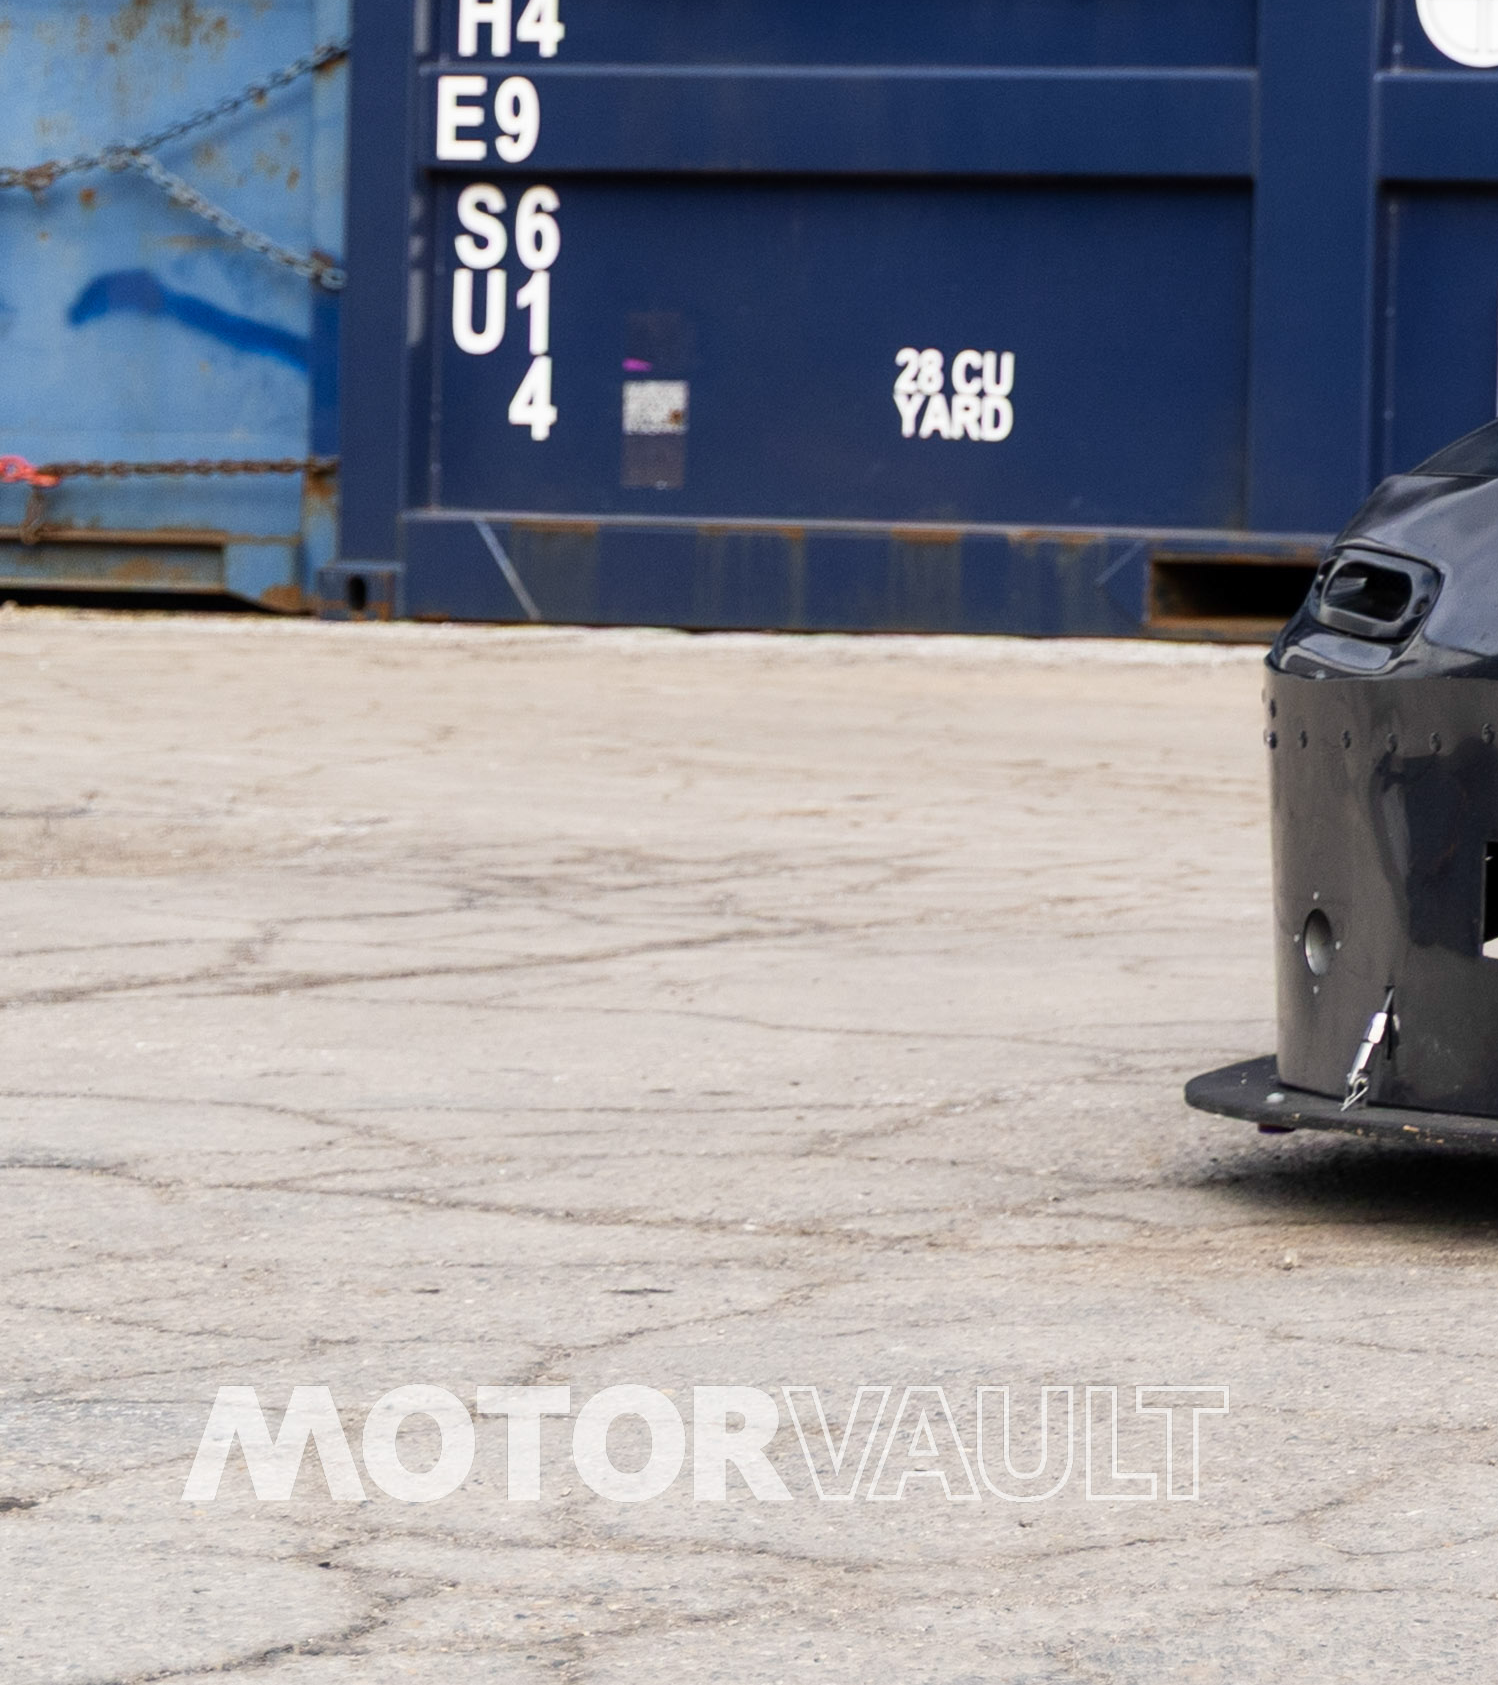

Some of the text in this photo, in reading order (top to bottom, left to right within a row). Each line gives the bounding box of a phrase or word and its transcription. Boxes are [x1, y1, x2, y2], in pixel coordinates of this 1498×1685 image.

[893, 348, 1015, 397] 28 CU
[893, 394, 1015, 442] YARD
